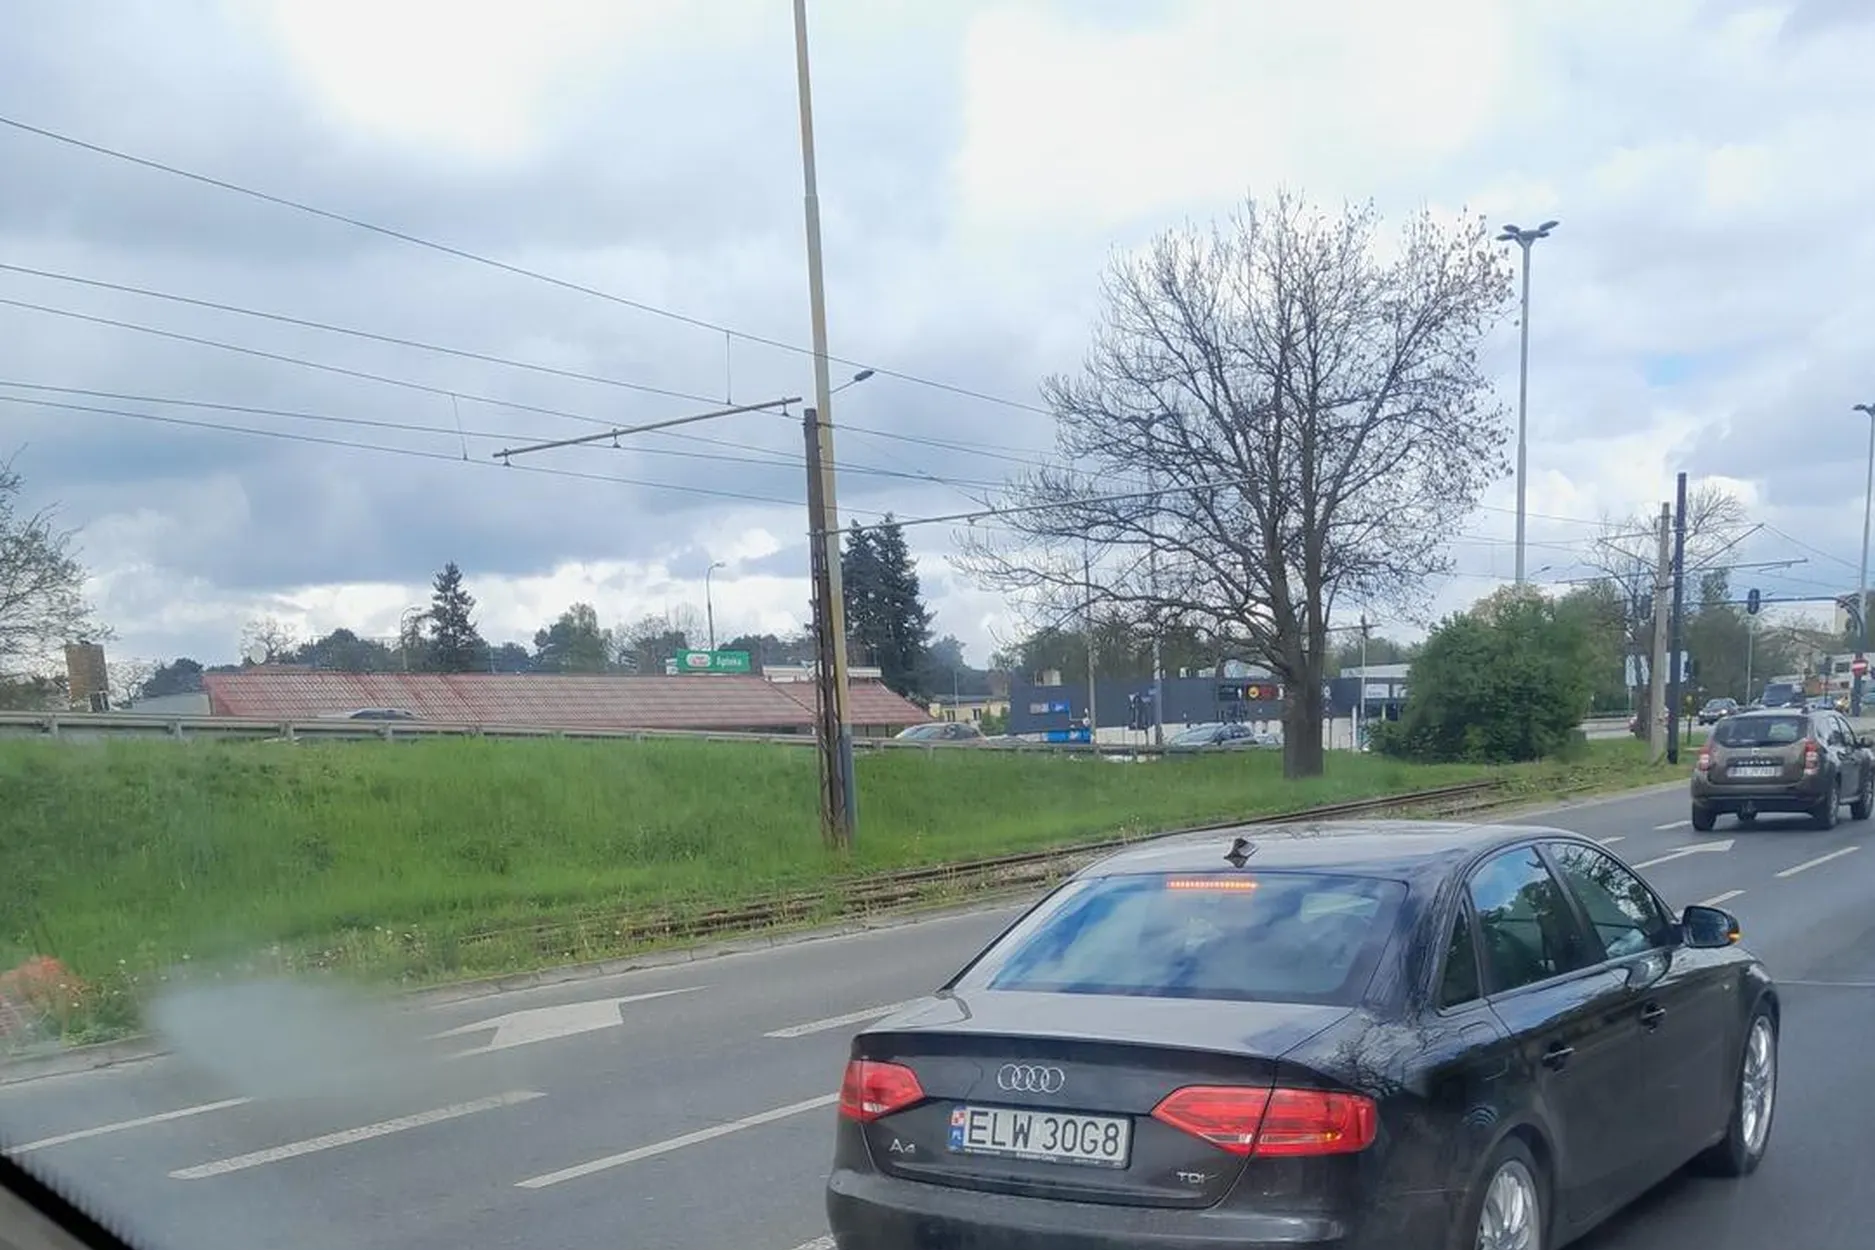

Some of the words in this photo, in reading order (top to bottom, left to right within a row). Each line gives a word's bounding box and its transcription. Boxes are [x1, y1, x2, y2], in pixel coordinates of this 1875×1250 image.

[968, 1110, 1033, 1149] ELW
[1042, 1117, 1120, 1157] 30G8
[1176, 1171, 1205, 1184] TDI
